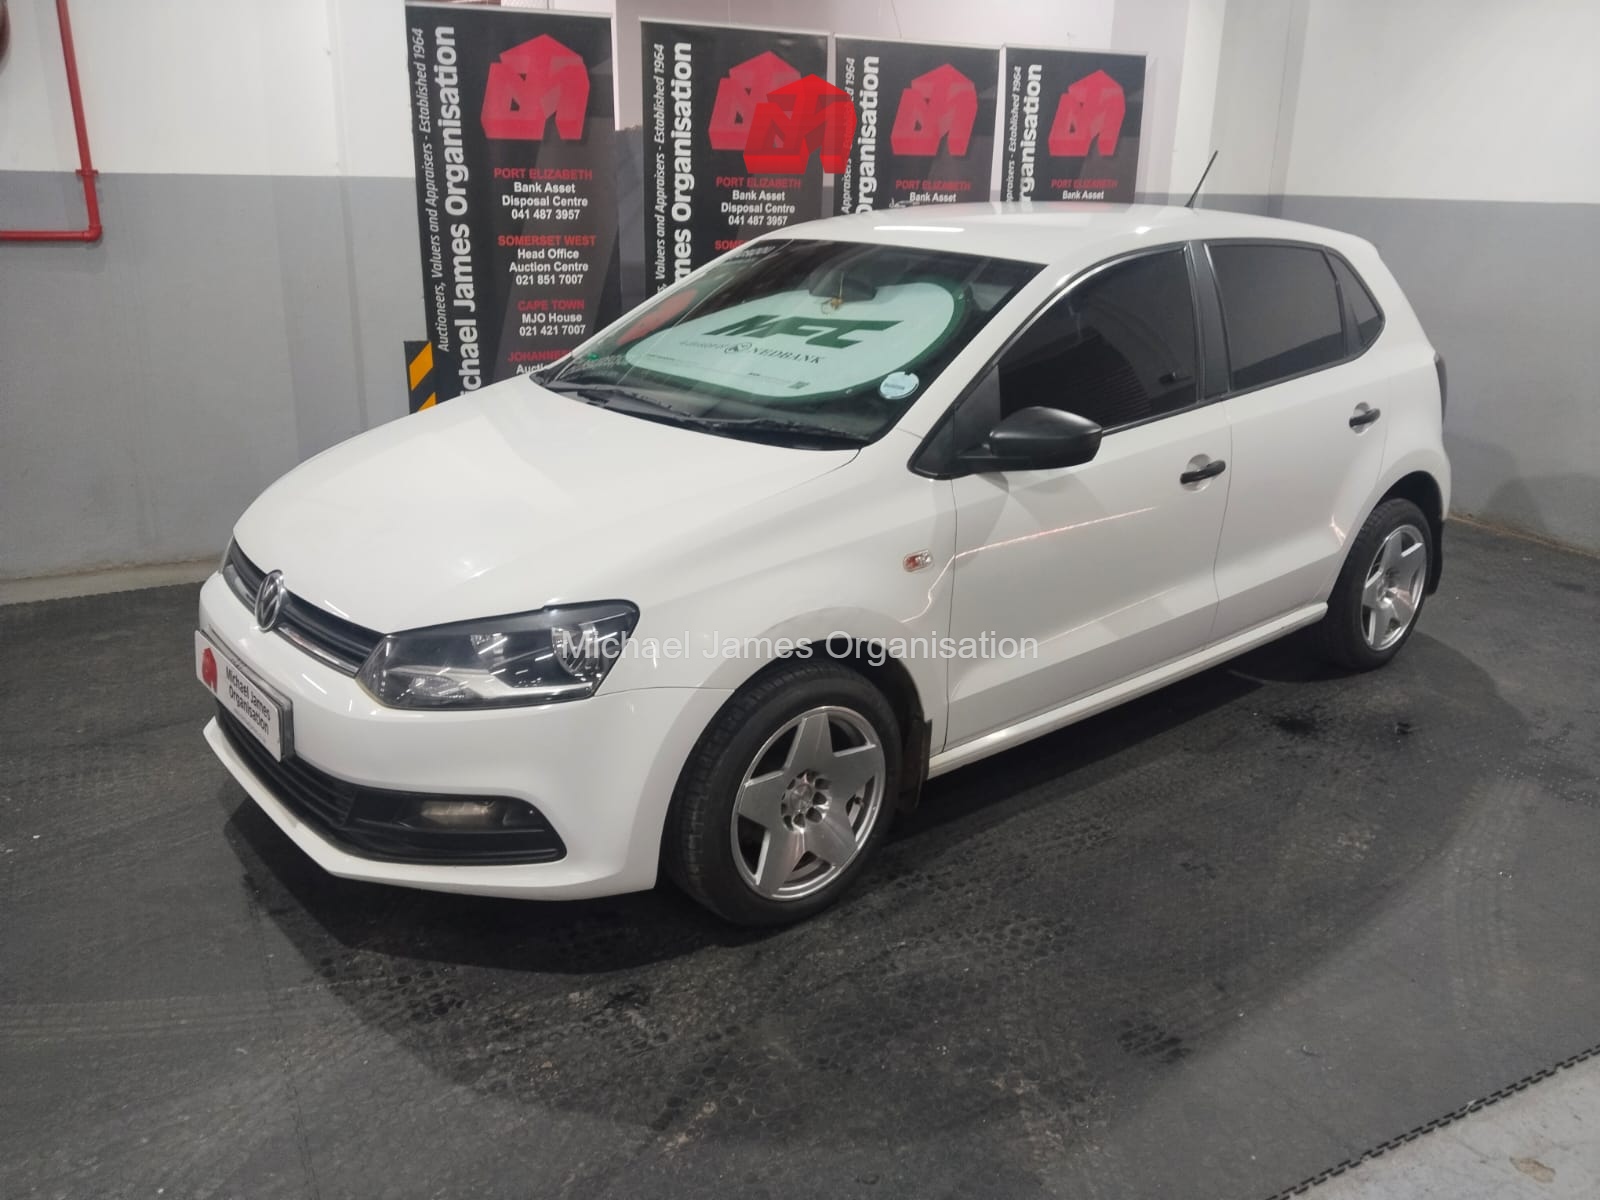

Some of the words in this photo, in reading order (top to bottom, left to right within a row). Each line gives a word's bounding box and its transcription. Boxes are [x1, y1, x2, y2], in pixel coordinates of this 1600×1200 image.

[411, 28, 425, 61] 1964
[653, 43, 665, 74] 1964
[845, 57, 855, 86] 1964
[1012, 65, 1022, 92] 1964
[413, 62, 431, 133] Established
[653, 74, 665, 144] Established
[434, 26, 469, 216] Organisation
[671, 42, 695, 222] Organisation
[1008, 94, 1020, 152] Established
[1020, 64, 1042, 202] rganisation
[421, 143, 439, 207] Appraisers
[494, 168, 526, 179] PORT
[529, 168, 592, 180] ELIZABETH
[513, 181, 542, 193] Bank
[544, 182, 576, 193] Asset
[653, 153, 667, 214] Appraisers
[716, 177, 744, 187] PORT
[746, 177, 801, 188] ELIZABETH
[895, 180, 919, 190] PORT
[1051, 178, 1072, 188] PORT
[502, 195, 550, 208] Disposal
[552, 195, 588, 206] Centre
[732, 190, 757, 200] Bank
[758, 190, 785, 201] Asset
[909, 191, 931, 202] Bank
[932, 192, 957, 203] Asset
[1062, 190, 1081, 200] Bank
[1081, 190, 1104, 200] Asset
[425, 208, 440, 233] and
[511, 208, 529, 220] 041
[533, 209, 552, 220] 487
[555, 209, 580, 220] 3957
[721, 202, 763, 215] Disposal
[765, 203, 795, 213] Centre
[728, 215, 745, 226] 041
[747, 215, 764, 226] 487
[766, 215, 788, 226] 3957
[654, 214, 665, 237] and
[497, 235, 561, 246] SOMERSET
[563, 235, 597, 246] WEST
[429, 234, 443, 278] Valuers
[509, 262, 550, 272] Auction
[553, 262, 589, 272] Centre
[517, 249, 545, 259] Head
[548, 249, 579, 259] Office
[655, 239, 665, 280] Valuers
[673, 229, 692, 283] mes
[450, 223, 476, 313] James
[515, 275, 534, 285] 021
[537, 275, 556, 285] 851
[559, 274, 583, 285] 7007
[435, 282, 450, 352] Auctioneers,
[517, 300, 548, 310] CAPE
[552, 300, 585, 310] TOWN
[522, 313, 546, 323] MJO
[549, 312, 583, 323] House
[519, 326, 537, 337] 021
[540, 325, 559, 336] 421
[562, 325, 586, 335] 7007
[703, 315, 904, 349] MFC
[454, 319, 482, 395] chael
[226, 666, 249, 699] Michael
[251, 691, 271, 721] James
[229, 685, 270, 735] Organisation
